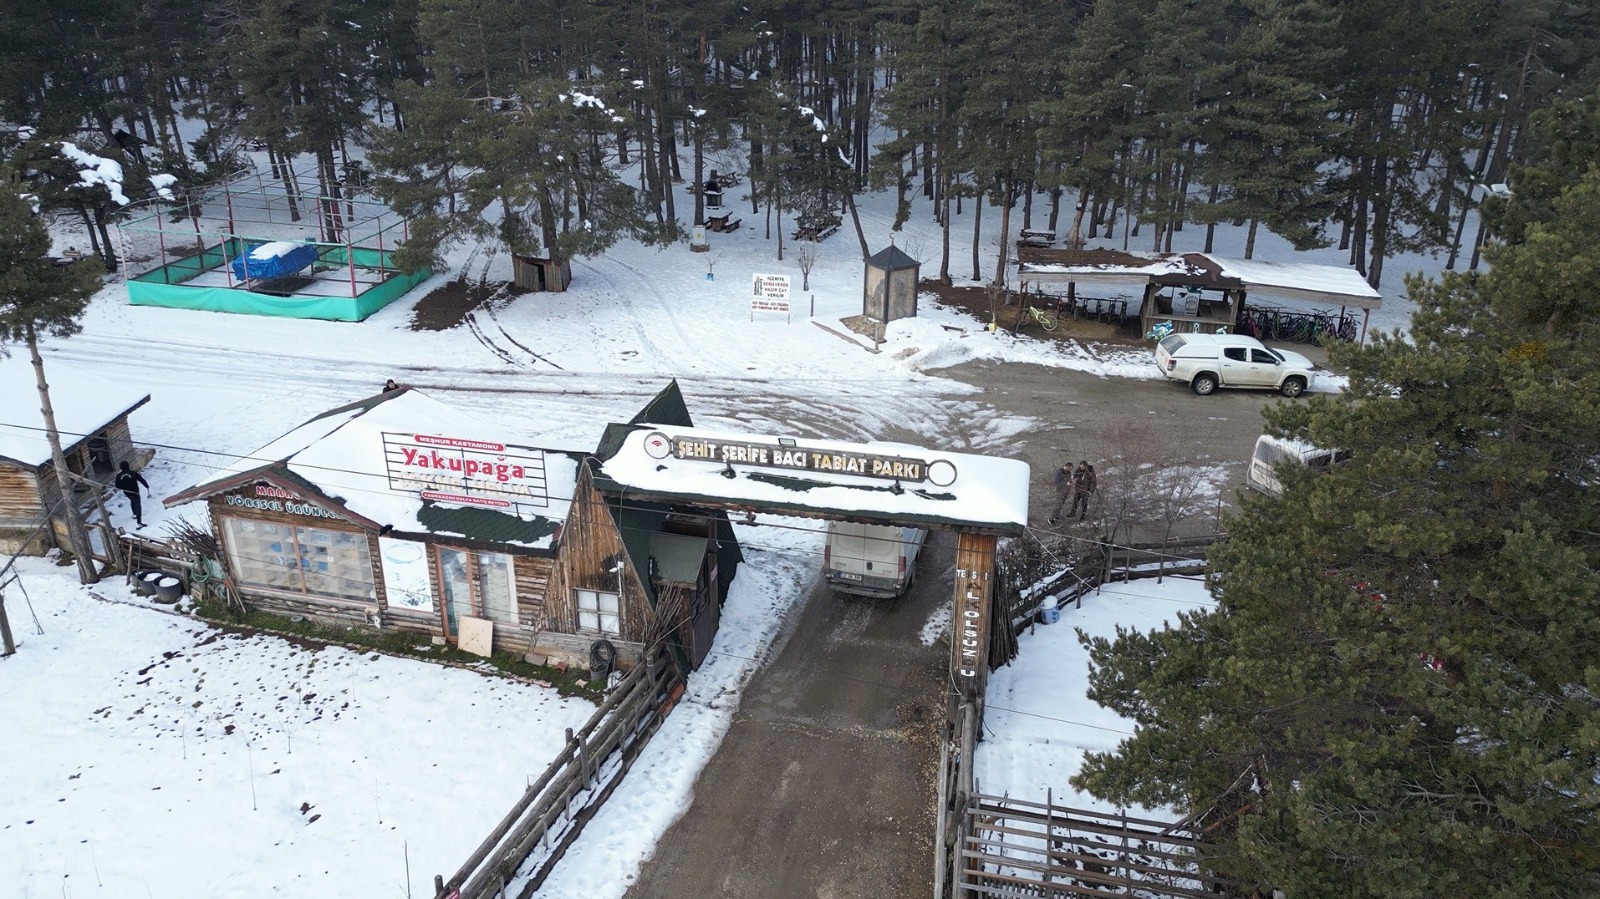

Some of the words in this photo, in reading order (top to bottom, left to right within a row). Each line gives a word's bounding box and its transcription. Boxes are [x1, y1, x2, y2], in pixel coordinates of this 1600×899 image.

[419, 436, 451, 446] MEŞHUR
[451, 440, 499, 451] KASTAMONU
[401, 446, 525, 482] Yakupağa
[678, 440, 717, 459] ŞEHİT
[722, 444, 768, 463] ŞERİFE
[773, 450, 807, 467] BACI
[812, 453, 867, 473] TABİAT
[872, 459, 920, 479] PARKI
[226, 494, 283, 512] YÖRESEL
